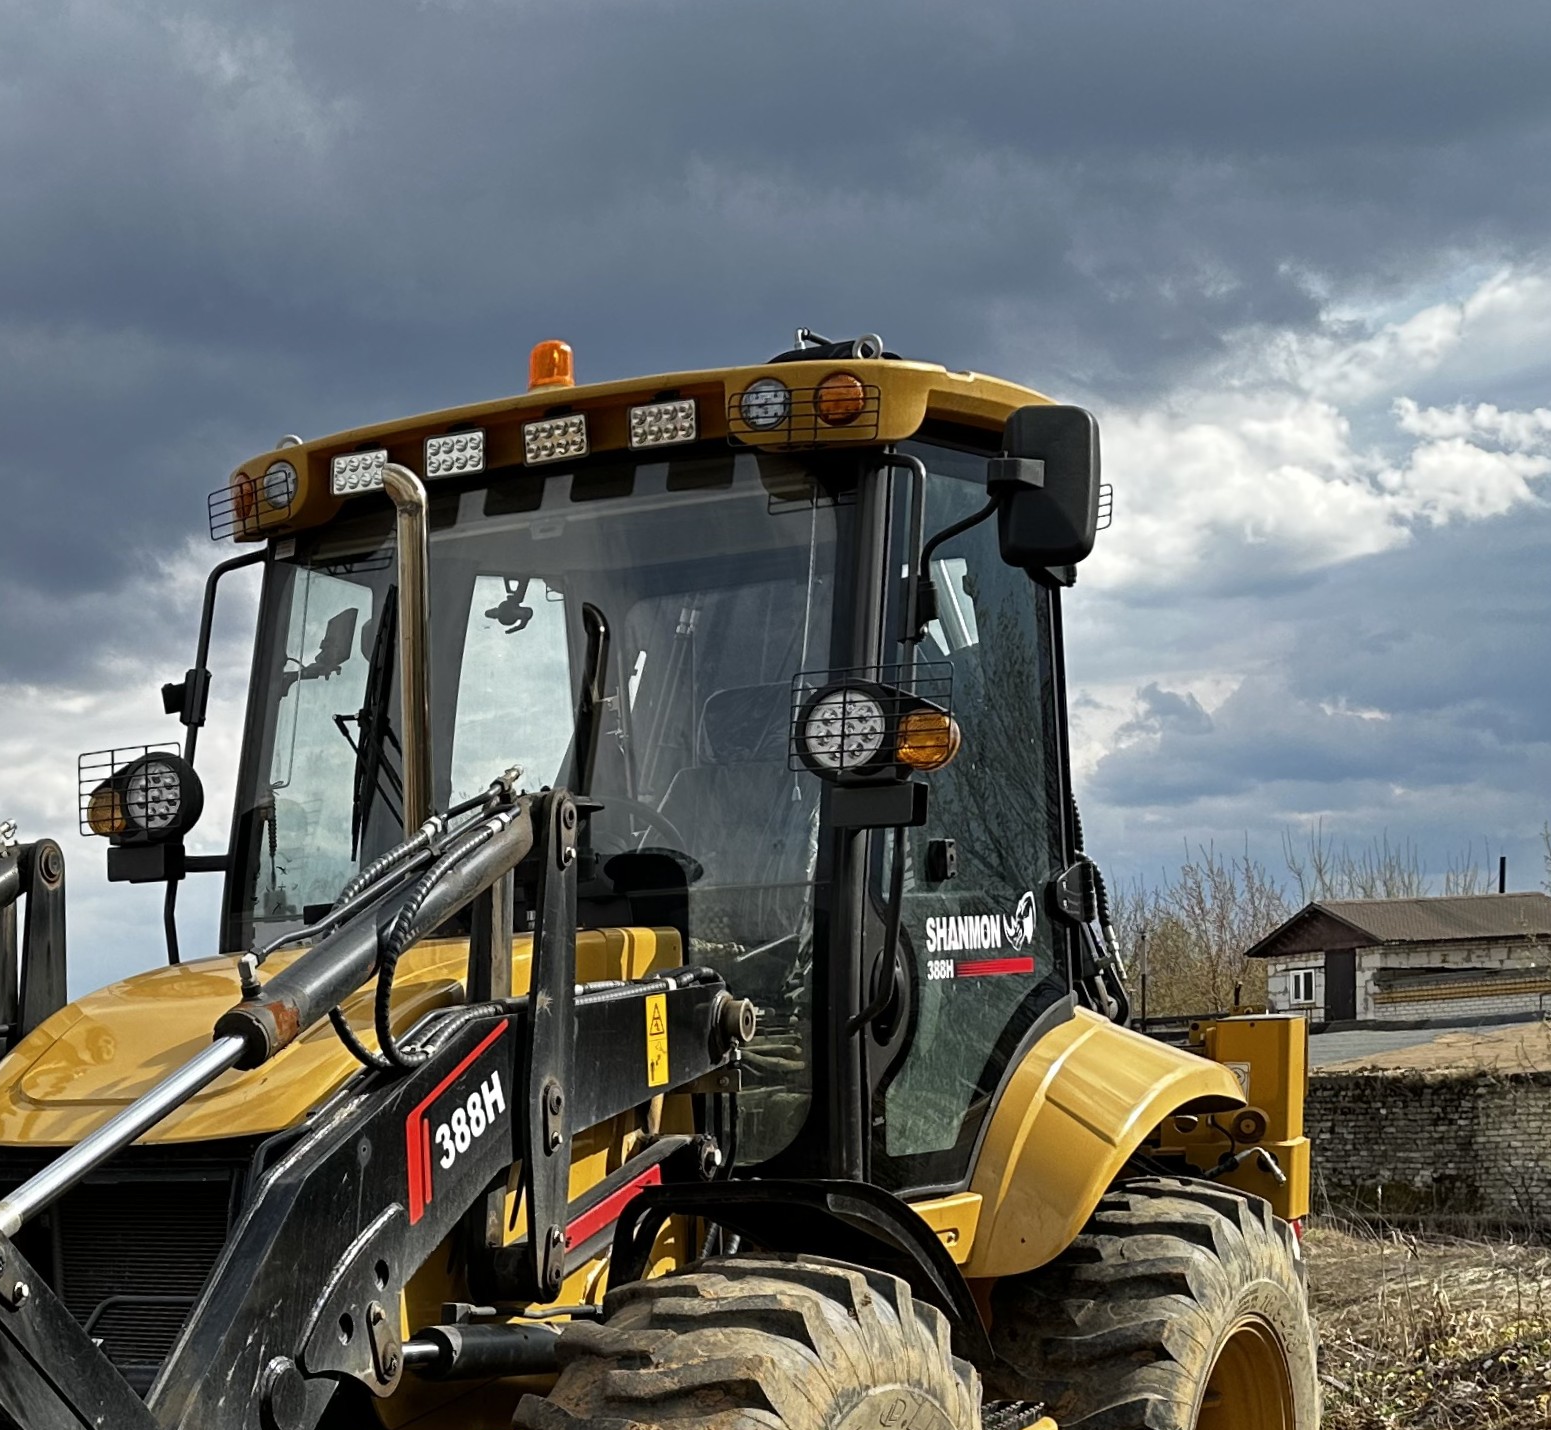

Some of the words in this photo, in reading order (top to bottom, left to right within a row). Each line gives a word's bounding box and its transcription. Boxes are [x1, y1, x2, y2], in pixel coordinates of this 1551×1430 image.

[925, 914, 1002, 952] SHANMON
[927, 959, 955, 980] 388H
[435, 1070, 506, 1169] 388H
